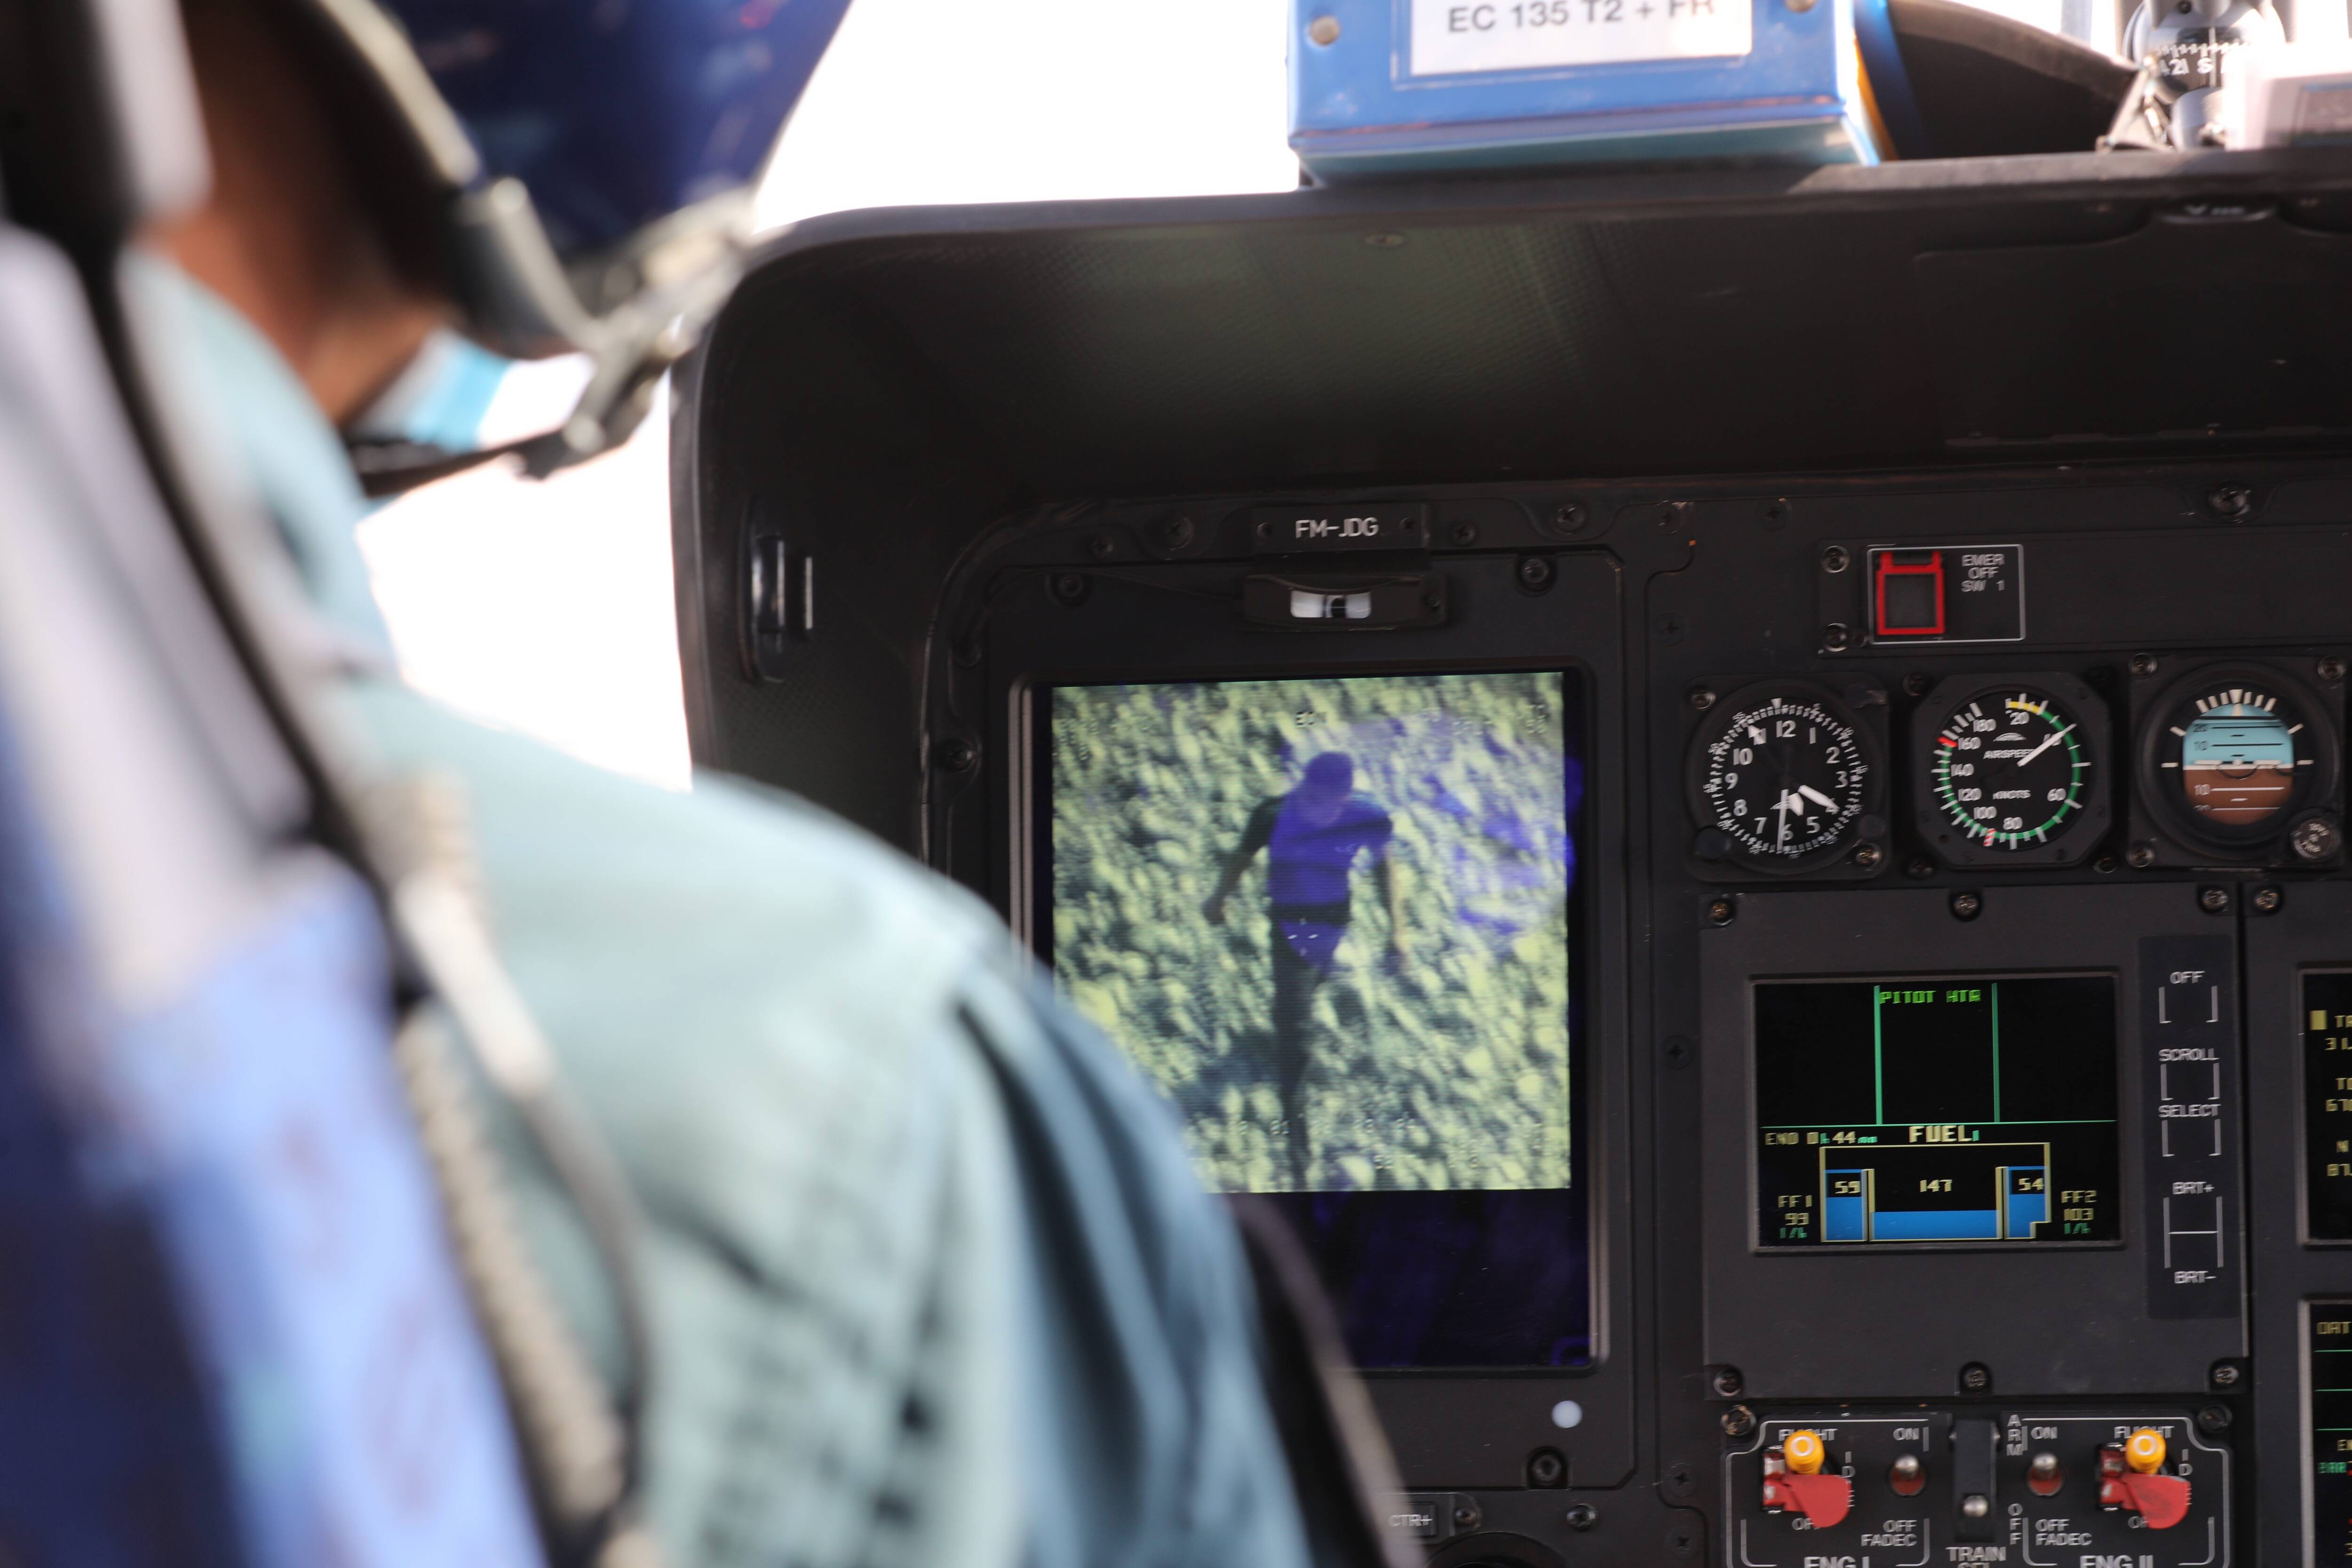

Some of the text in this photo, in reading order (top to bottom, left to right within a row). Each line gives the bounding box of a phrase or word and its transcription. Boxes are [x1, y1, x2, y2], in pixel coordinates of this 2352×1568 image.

[1448, 5, 1496, 33] EC
[1510, 0, 1569, 28] 135
[1580, 0, 1624, 23] T2
[1295, 517, 1379, 539] FM-JDG
[1962, 553, 2005, 566] EMER
[1968, 566, 1999, 580] OFF
[1996, 580, 2005, 591] 1
[1973, 718, 1997, 732] 180
[2009, 711, 2030, 725] 20
[1776, 720, 1796, 738] 12
[1809, 727, 1816, 744] 1
[1958, 736, 1981, 750] 160
[1733, 748, 1753, 765] 10
[1826, 747, 1840, 764] 2
[1951, 763, 1975, 777] 140
[1724, 772, 1739, 790] 9
[1835, 771, 1849, 788] 3
[1958, 788, 1982, 802] 120
[2047, 788, 2067, 802] 60
[2194, 784, 2210, 796] 10
[1733, 799, 1748, 816] 8
[1973, 806, 1997, 820] 100
[1754, 817, 1767, 835] 7
[1806, 816, 1820, 834] 5
[2002, 816, 2023, 830] 80
[2169, 971, 2206, 984] OFF
[1880, 991, 1937, 1004] PITOT
[2159, 1048, 2220, 1062] SCROLL
[2158, 1104, 2221, 1118] SELECT
[1909, 1125, 1972, 1143] FUEL
[1920, 1179, 1953, 1192] 147
[2018, 1178, 2044, 1191] 54
[2061, 1190, 2097, 1203] FF2
[1893, 1427, 1920, 1441] ON
[2030, 1426, 2058, 1440] ON
[1883, 1520, 1917, 1532] OFF
[2035, 1519, 2070, 1532] OFF
[1860, 1534, 1917, 1547] FADEC
[2035, 1532, 2093, 1546] FADEC
[1945, 1546, 2007, 1562] TRAIN
